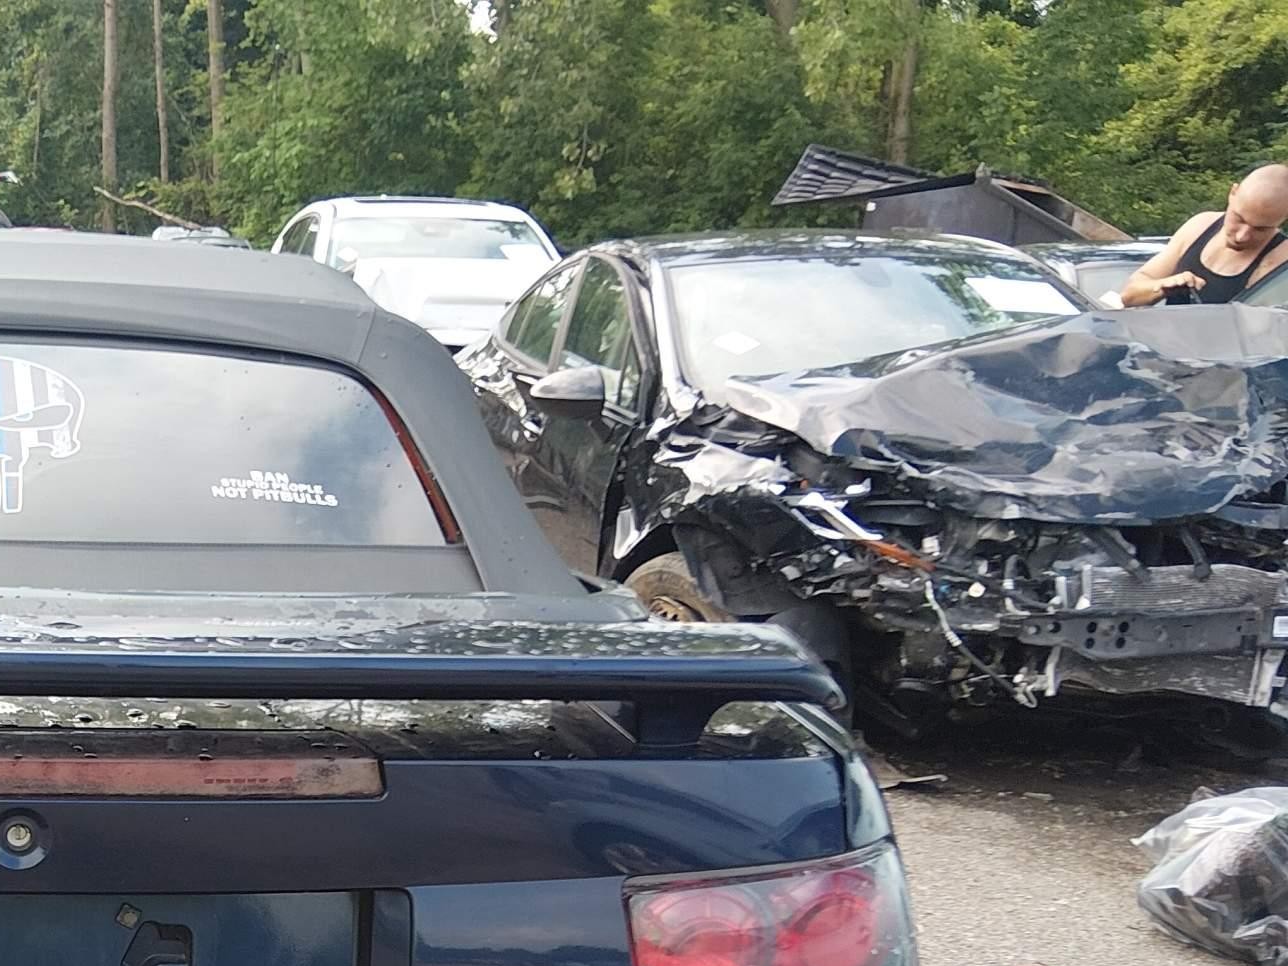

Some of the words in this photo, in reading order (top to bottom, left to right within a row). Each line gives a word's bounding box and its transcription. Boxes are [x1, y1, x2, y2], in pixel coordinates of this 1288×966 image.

[249, 470, 290, 483] BAN
[212, 486, 248, 499] NOT
[252, 488, 339, 507] PITBULLS
